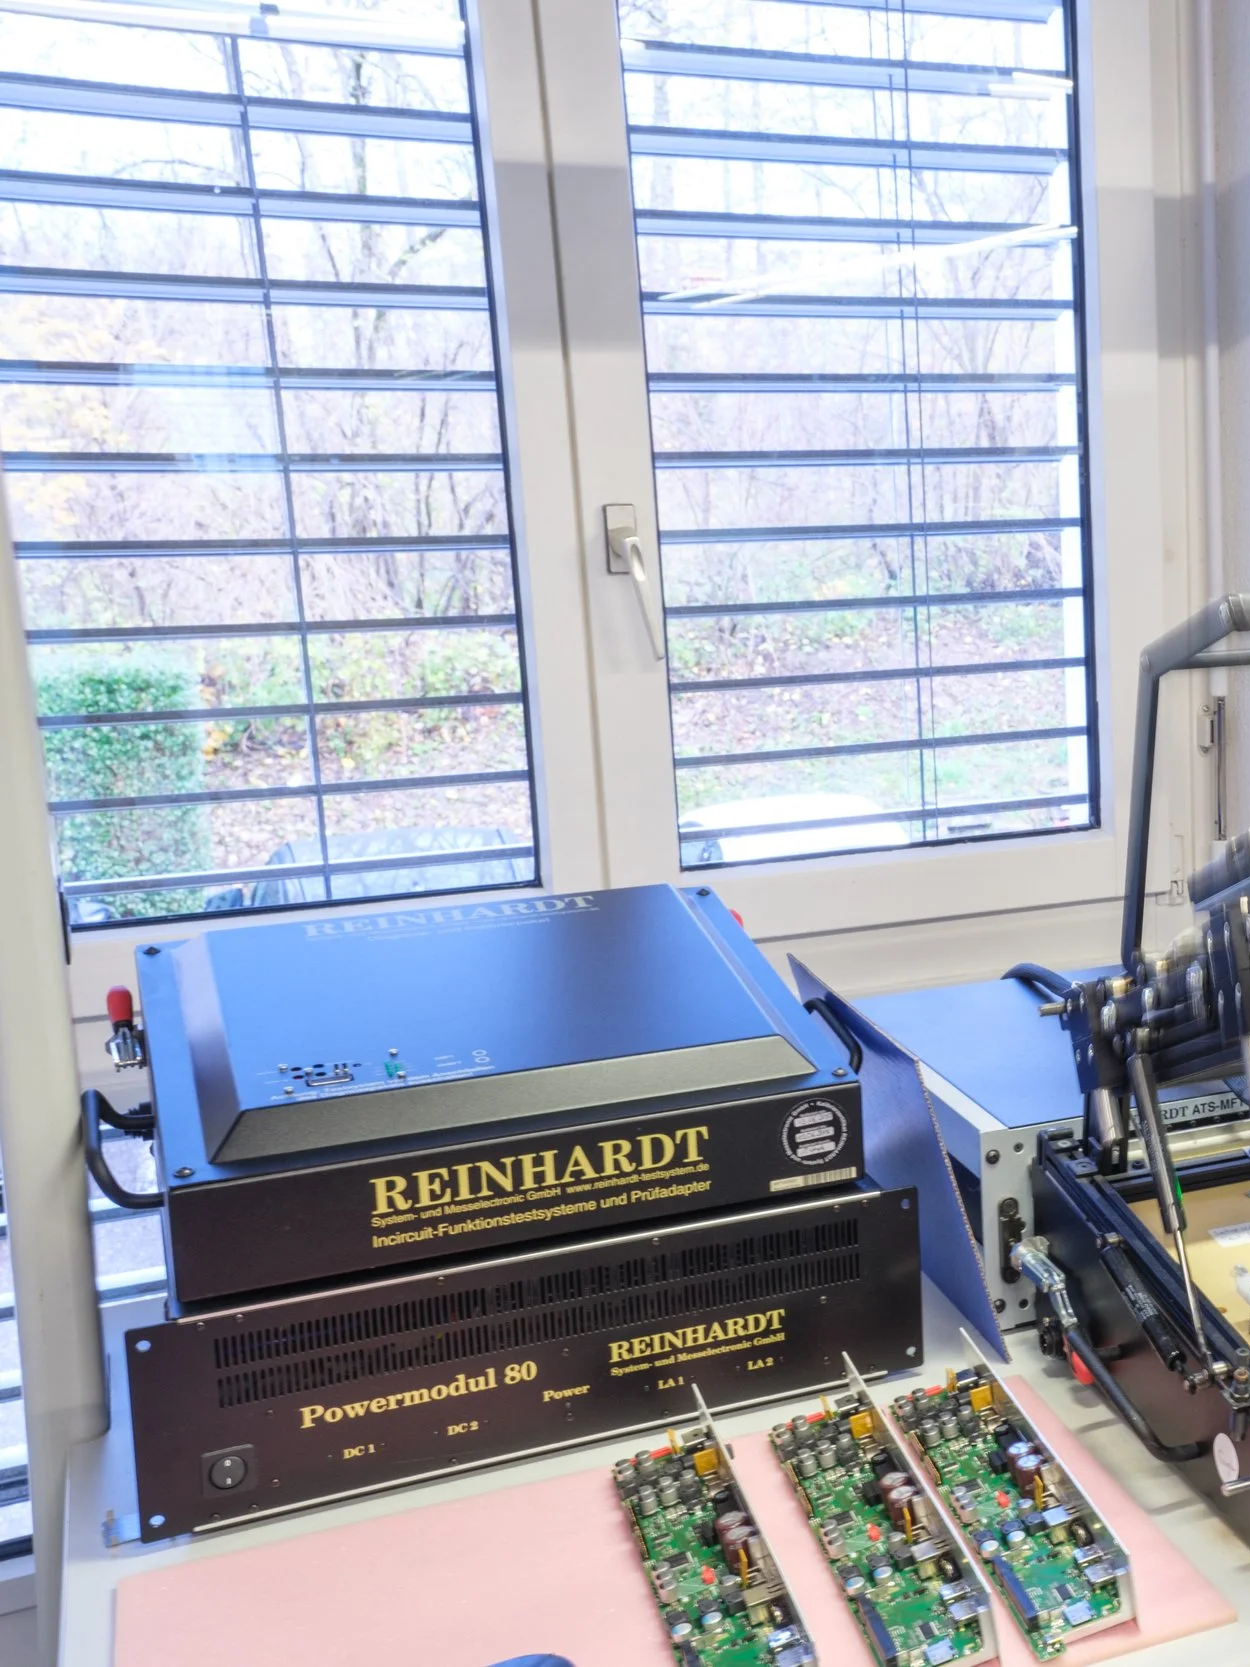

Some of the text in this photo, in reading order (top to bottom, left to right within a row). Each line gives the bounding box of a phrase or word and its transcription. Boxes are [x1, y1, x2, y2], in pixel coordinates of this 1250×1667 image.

[302, 895, 595, 938] REINHARDT
[369, 1126, 709, 1215] REINHARDT
[371, 1162, 710, 1229] System- und Messelectronic GmbH www.reinhardt-testsystem.de
[372, 1180, 712, 1248] Incircuit-Funktionstestsysteme und Prüfadapter
[608, 1308, 786, 1363] REINHARDT
[610, 1332, 786, 1377] System- und Messelectronic GmbH
[657, 1378, 678, 1390] LA
[747, 1357, 774, 1371] LA 2
[299, 1360, 538, 1429] Powermodul 80
[543, 1384, 591, 1402] Power
[447, 1420, 480, 1436] DC 2
[343, 1443, 376, 1459] DC 1
